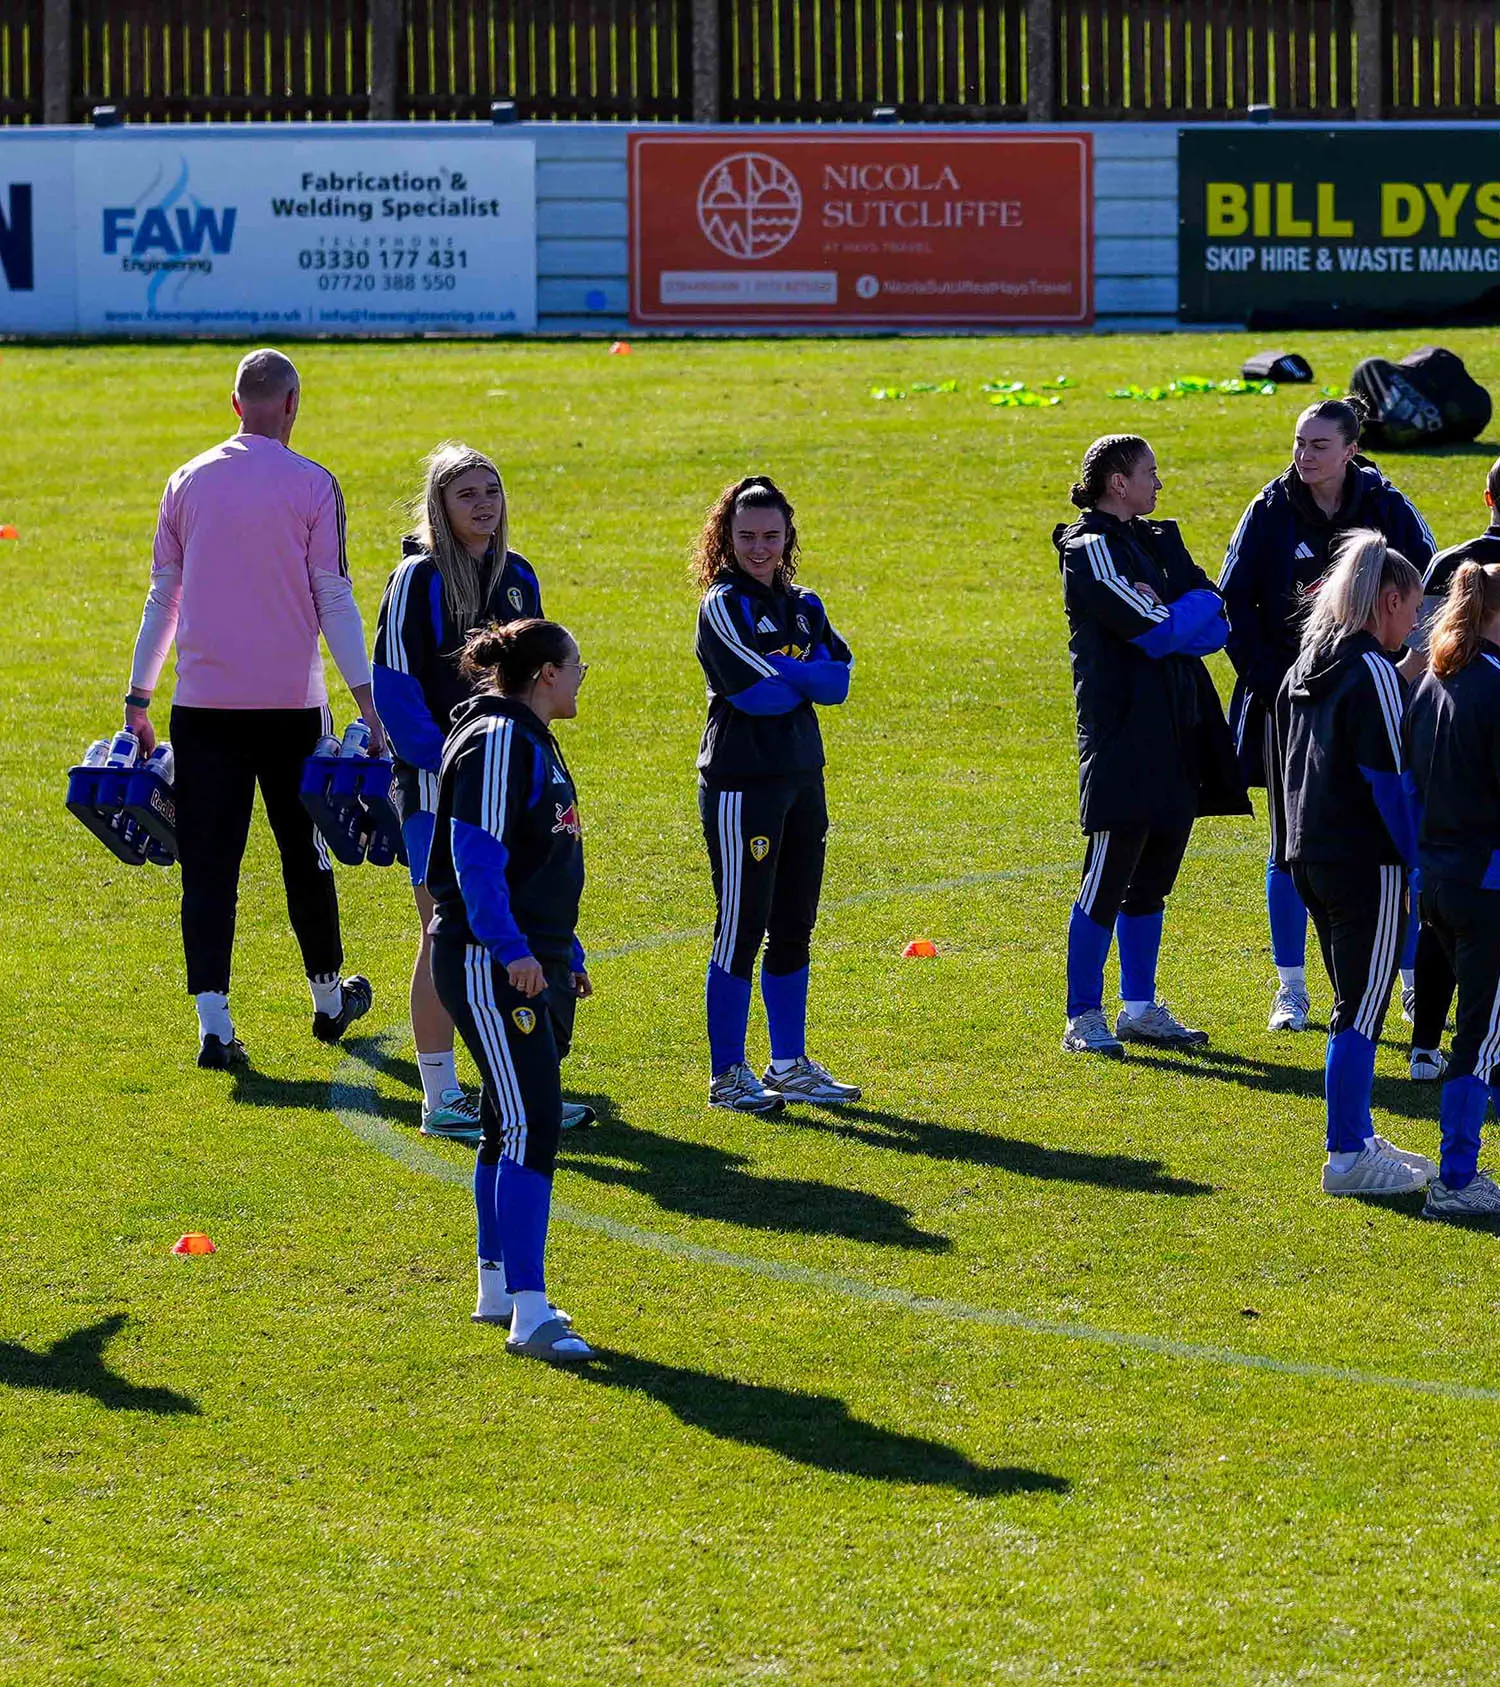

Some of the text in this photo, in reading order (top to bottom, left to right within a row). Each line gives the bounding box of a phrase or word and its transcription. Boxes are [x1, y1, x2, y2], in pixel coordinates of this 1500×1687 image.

[301, 171, 468, 192] Fabrication &
[822, 164, 961, 191] NICOLA
[272, 197, 500, 222] Welding Specialist
[822, 200, 1024, 228] SUTCLIFFE
[1206, 182, 1355, 238] BILL
[103, 207, 238, 255] FAW
[122, 256, 213, 275] Engineering
[298, 250, 468, 270] 03330 177 431
[1205, 246, 1256, 272] SKIP
[1260, 246, 1311, 272] HIRE
[1316, 247, 1333, 272] &
[1337, 246, 1414, 272] WASTE
[319, 274, 456, 291] 07720 388 550
